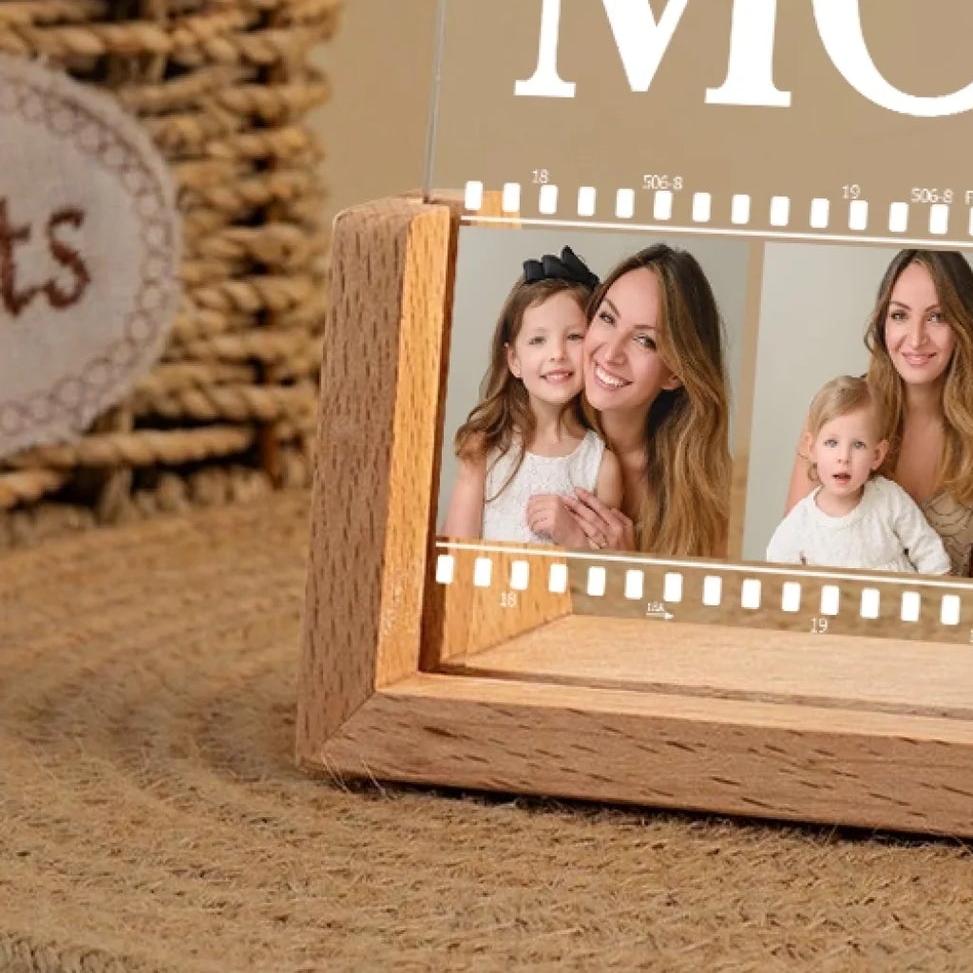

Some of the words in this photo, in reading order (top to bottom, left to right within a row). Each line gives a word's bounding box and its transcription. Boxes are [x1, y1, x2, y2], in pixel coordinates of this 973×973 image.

[532, 169, 549, 184] 18
[841, 184, 861, 200] 19
[500, 592, 517, 608] 18
[810, 618, 828, 634] 19
